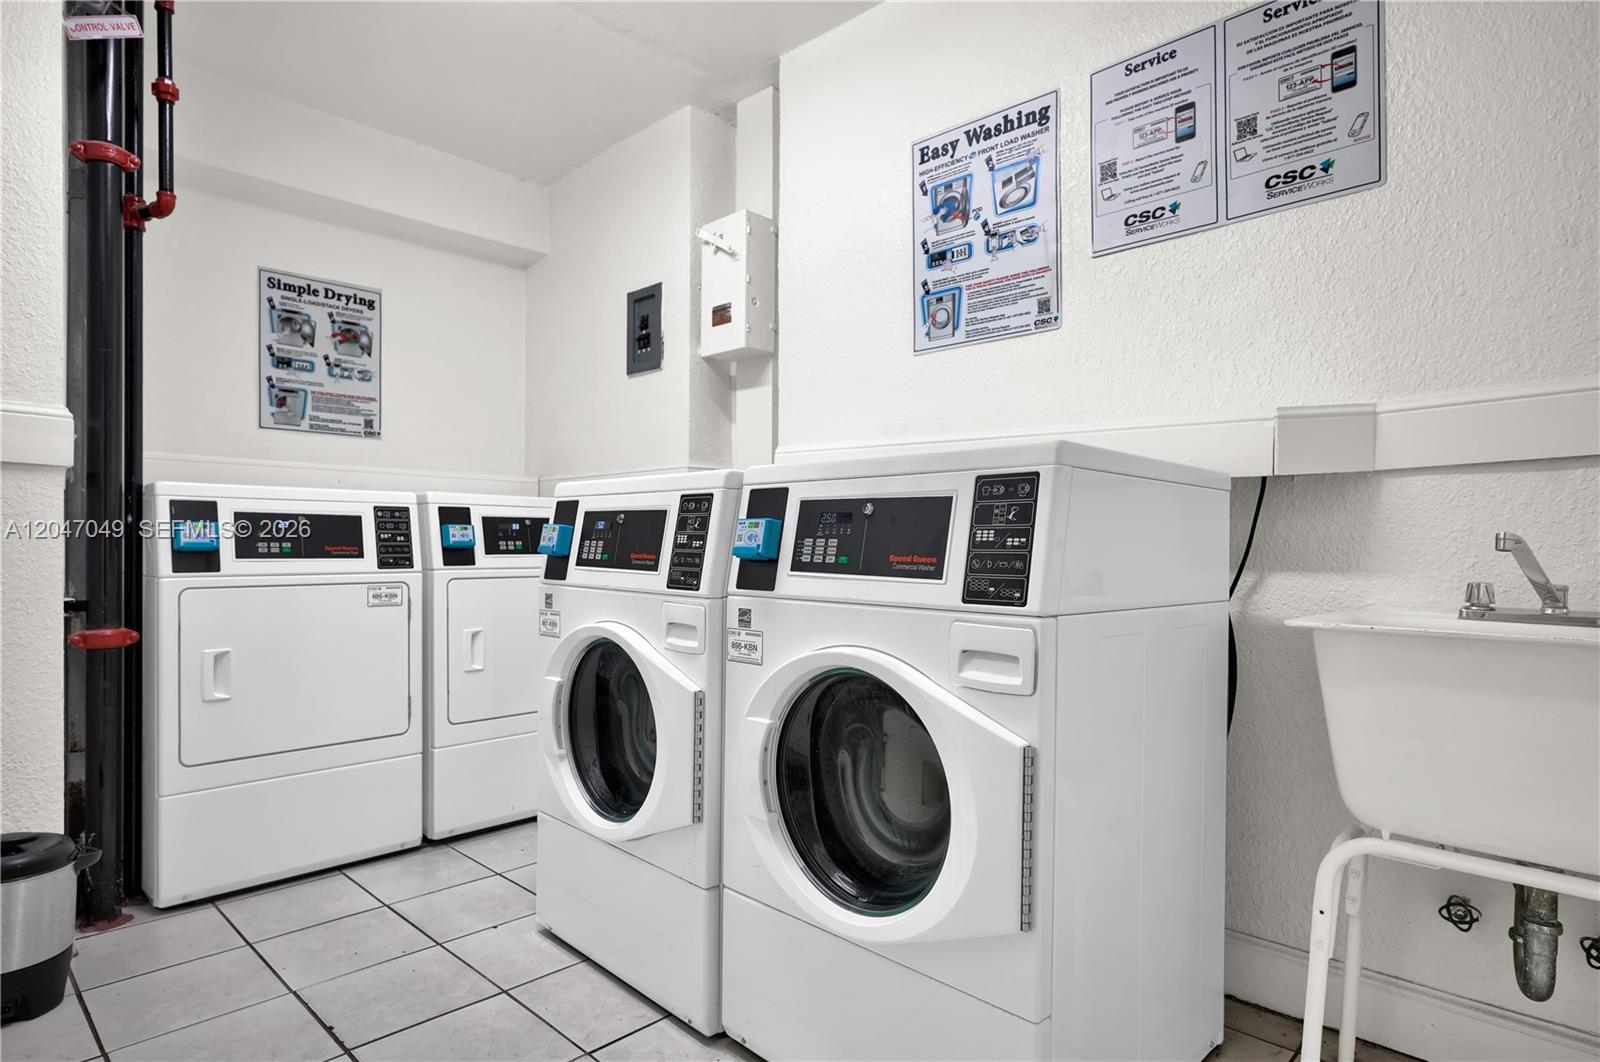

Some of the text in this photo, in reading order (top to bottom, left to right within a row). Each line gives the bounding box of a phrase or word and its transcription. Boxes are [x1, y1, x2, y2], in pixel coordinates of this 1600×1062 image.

[110, 22, 136, 31] VALVE
[1124, 48, 1177, 77] Service
[1286, 76, 1314, 90] 123-APP
[918, 138, 960, 165] Easy
[964, 105, 1050, 147] Washing
[919, 155, 968, 176] HIGH-EFFICIENCY
[977, 143, 998, 156] FRONT
[1000, 137, 1018, 150] LOAD
[1020, 126, 1050, 141] WASHER
[1264, 164, 1316, 190] CSC
[1124, 206, 1166, 227] CSC
[266, 276, 320, 298] Simple
[324, 288, 376, 310] Drying
[341, 306, 364, 315] DRYERS
[1033, 317, 1052, 328] CSC
[888, 552, 937, 563] Speed Queen
[731, 641, 758, 652] 898-KBN
